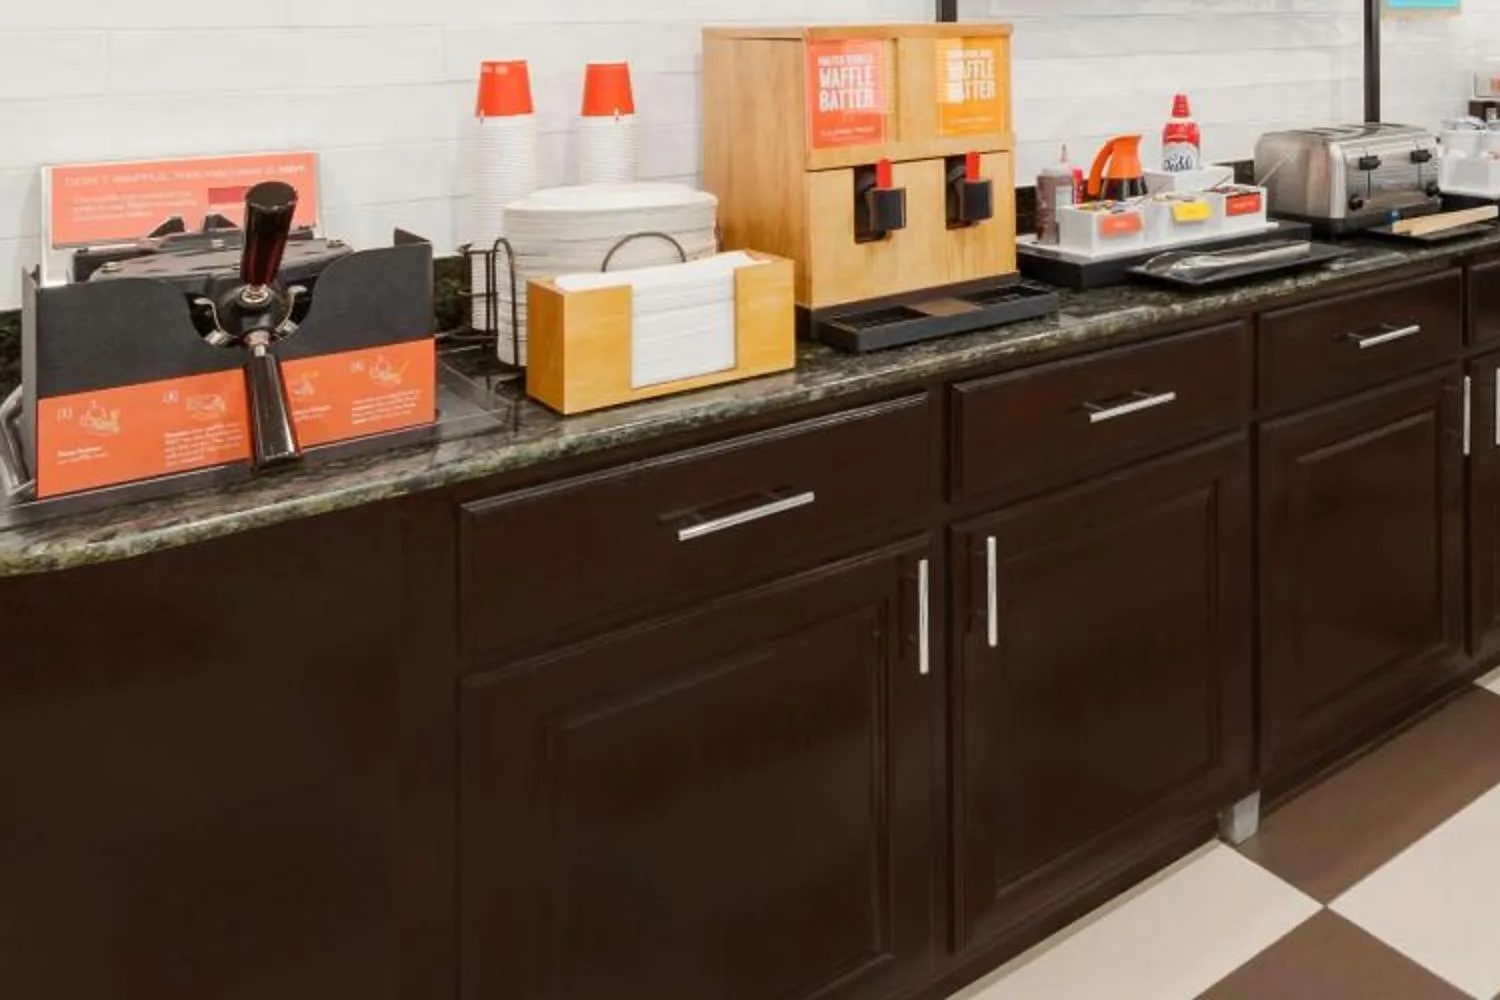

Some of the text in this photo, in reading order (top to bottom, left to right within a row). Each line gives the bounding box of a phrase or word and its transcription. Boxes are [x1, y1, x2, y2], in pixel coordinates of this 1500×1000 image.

[818, 65, 876, 89] WAFFLE
[948, 59, 994, 81] AFFLE
[818, 88, 875, 112] BATTER
[948, 80, 995, 102] ATTER
